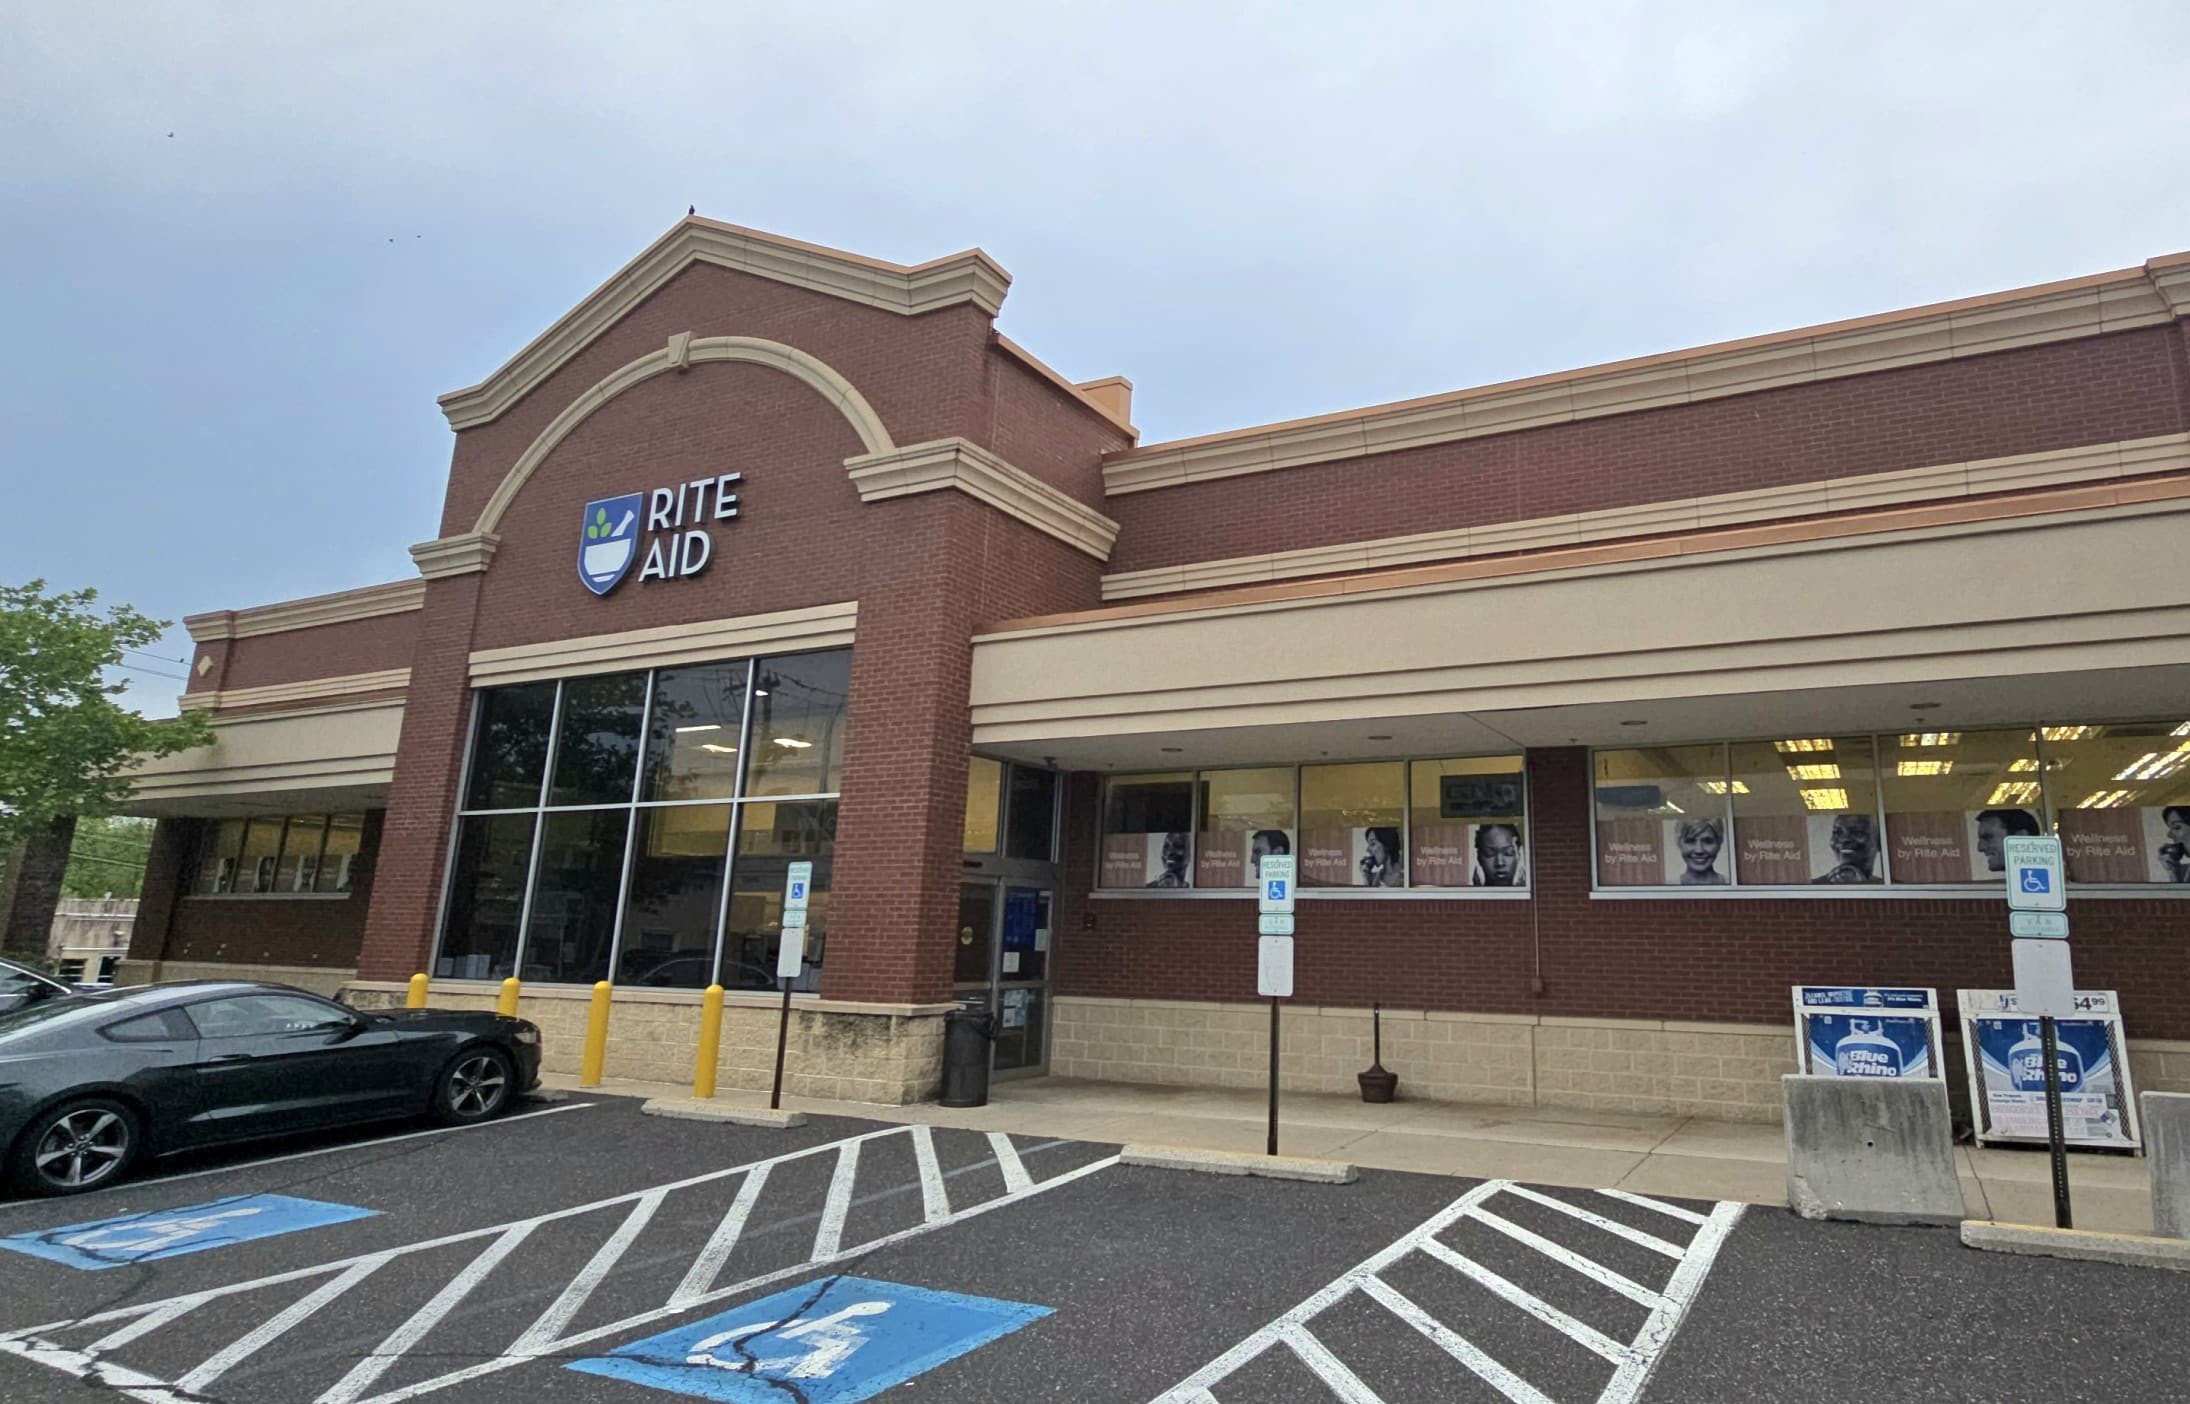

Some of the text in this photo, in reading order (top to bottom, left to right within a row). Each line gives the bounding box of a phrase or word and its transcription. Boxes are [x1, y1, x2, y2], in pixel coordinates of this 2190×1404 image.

[648, 472, 741, 531] RITE
[638, 530, 711, 582] AID
[1747, 839, 1795, 849] Wellness
[1901, 836, 1953, 846] Wellness
[2071, 832, 2128, 844] Wellness
[1897, 848, 1960, 860] by Rite Aid
[2008, 843, 2056, 853] RESERVED
[2066, 845, 2081, 858] by
[2115, 845, 2136, 856] Aid
[1744, 850, 1757, 862] by
[1783, 850, 1801, 860] Aid
[2013, 855, 2055, 866] PARKING
[1850, 1050, 1889, 1063] Blue
[2024, 1053, 2067, 1070] Ble
[1847, 1062, 1897, 1077] Rhino
[2022, 1068, 2077, 1083] Rhno
